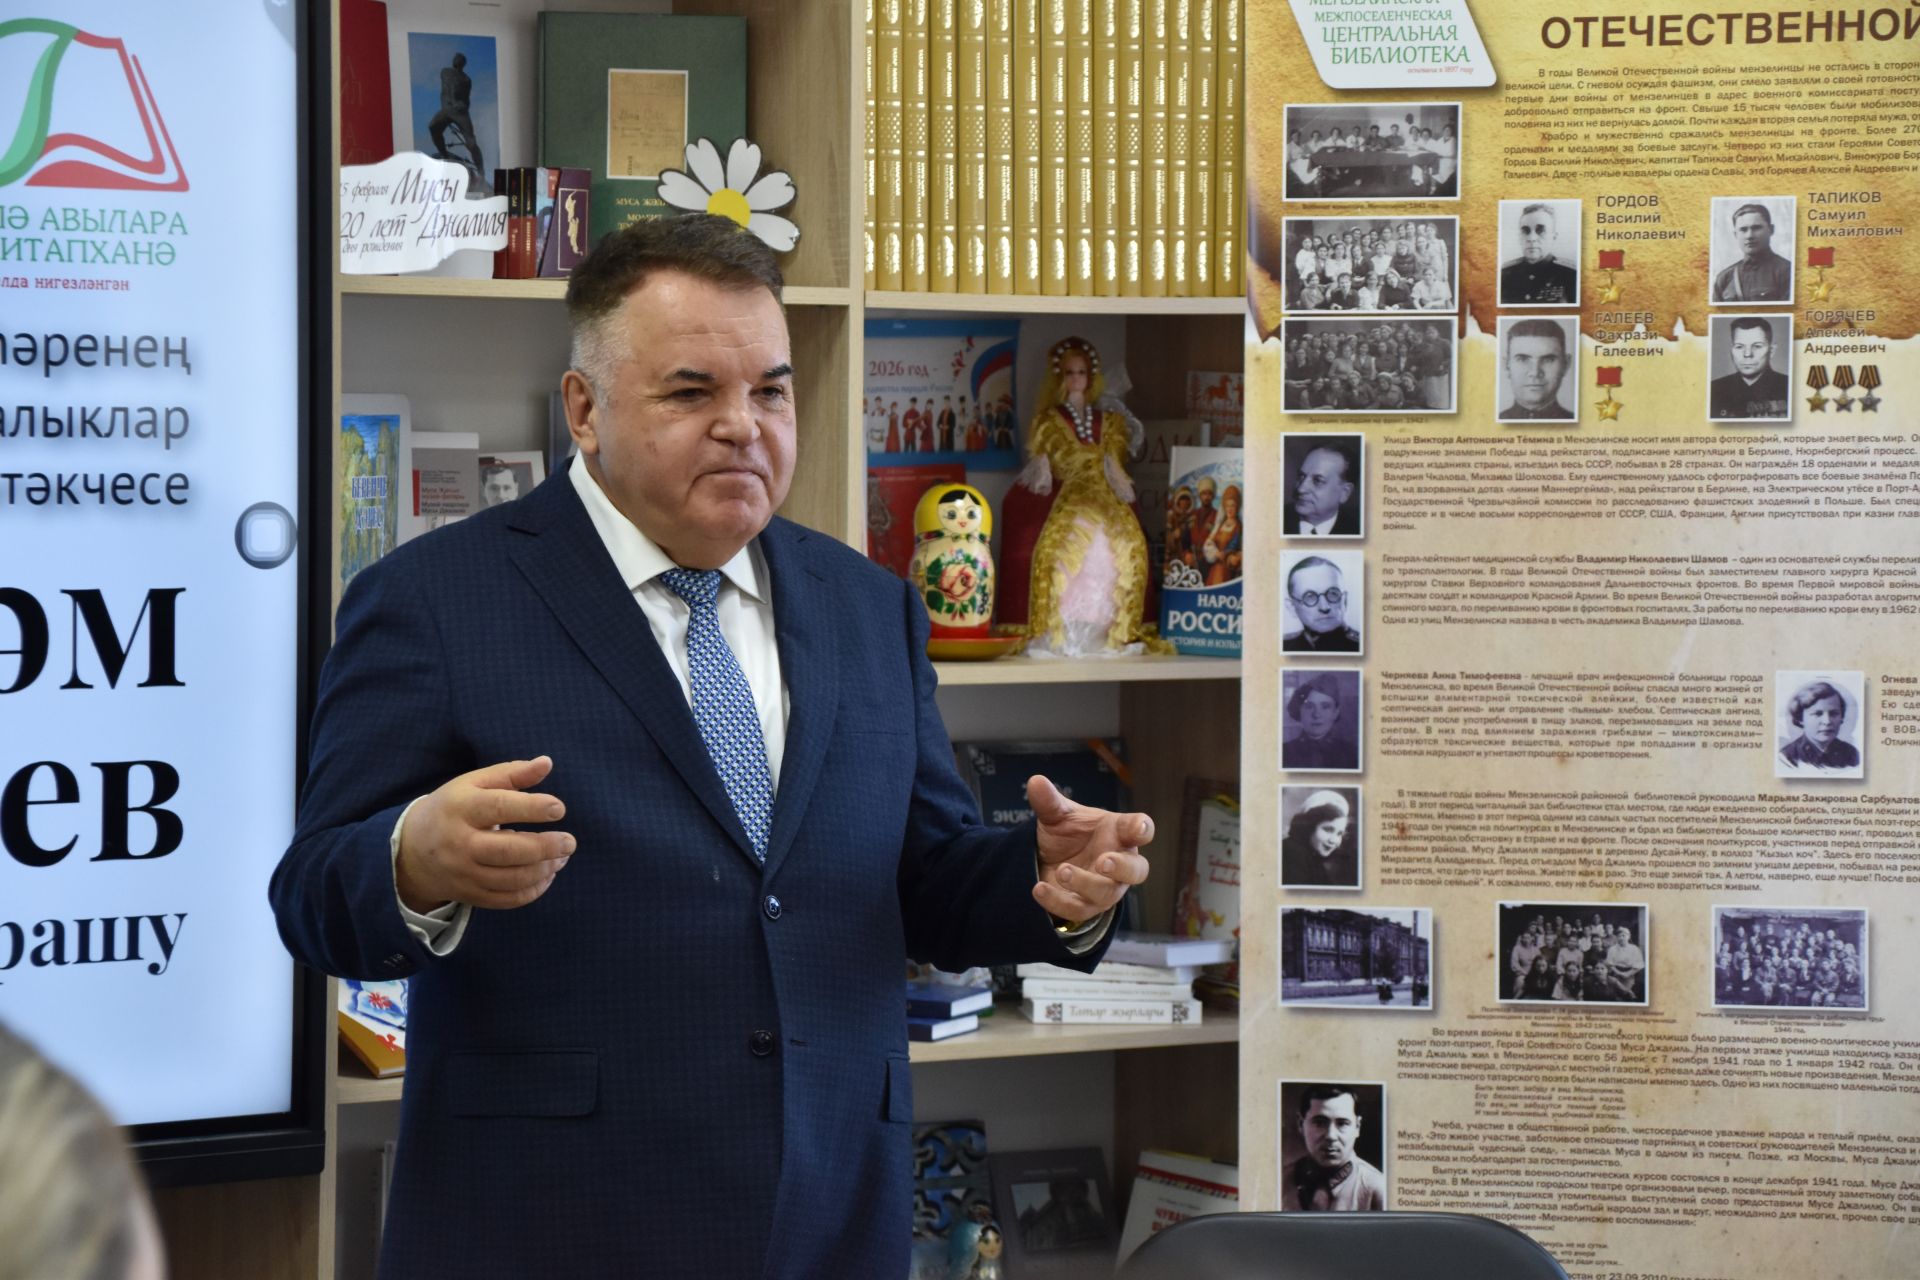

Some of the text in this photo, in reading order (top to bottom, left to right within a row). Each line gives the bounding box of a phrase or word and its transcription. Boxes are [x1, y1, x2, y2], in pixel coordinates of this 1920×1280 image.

[1315, 10, 1452, 22] МЕЖПОСЕЛЕНЧЕСКАЯ
[1322, 25, 1458, 46] ЦЕНТРАЛЬНАЯ
[1331, 46, 1471, 64] БИБЛИОТЕКА
[1538, 67, 1546, 77] В
[1549, 68, 1573, 78] годы
[1577, 65, 1619, 77] Великой
[1623, 64, 1699, 76] Отечественной
[1702, 63, 1736, 74] войны
[1739, 64, 1805, 76] мензелинцы
[1808, 63, 1821, 72] не
[1825, 62, 1870, 72] остались
[1873, 62, 1881, 71] в
[1505, 79, 1546, 90] великой
[1549, 80, 1574, 92] цели.
[1577, 78, 1584, 89] С
[1587, 79, 1624, 89] гневом
[1625, 78, 1668, 90] осуждая
[1670, 76, 1716, 89] фашизм,
[1719, 77, 1738, 86] они
[1740, 76, 1772, 86] смело
[1774, 75, 1821, 85] заявляли
[1822, 75, 1830, 84] о
[1832, 73, 1863, 84] своей
[391, 168, 459, 223] Мусы
[1597, 195, 1659, 208] ГОРДОВ
[1807, 191, 1882, 204] ТАПИКОВ
[0, 205, 188, 235] Ә АВЫЛАРА
[1597, 211, 1661, 224] Василий
[1807, 208, 1866, 223] Самуил
[370, 213, 407, 241] лет
[416, 203, 507, 247] Джалиля
[1596, 228, 1686, 240] Николаевич
[0, 277, 29, 289] лда
[1594, 312, 1654, 324] ГАЛЕЕВ
[1805, 310, 1876, 321] ГОРЯЧЕВ
[1594, 330, 1658, 342] Фахрази
[1805, 327, 1866, 338] Алексей
[0, 333, 191, 378] әренең
[1594, 345, 1664, 357] Галеевич
[1804, 342, 1886, 356] Андреевич
[868, 361, 930, 378] 2026 год
[1383, 433, 1920, 446] Улица Виктора Антоновича Тёмина в Мензелинске носит имя автора фотографий, которые знает весь мир. О
[1, 473, 190, 506] тәкчесе
[1382, 553, 1470, 566] Генерал-лейтенант
[1472, 553, 1538, 566] медицинской
[1539, 553, 1575, 566] службы
[1576, 553, 1627, 566] Владимир
[1628, 553, 1689, 564] Николаевич
[1691, 553, 1728, 564] Шамов
[1739, 555, 1764, 564] один
[1765, 555, 1777, 564] из
[1778, 553, 1841, 564] основателей
[1842, 553, 1880, 566] службы
[1167, 610, 1243, 634] РОССИ
[1381, 670, 1429, 683] Черняева
[1432, 670, 1457, 681] Анна
[1459, 670, 1522, 683] Тимофеевна
[1531, 670, 1573, 683] лечащий
[1577, 672, 1600, 683] врач
[1603, 670, 1675, 683] инфекционной
[1679, 671, 1726, 684] больницы
[1730, 673, 1763, 684] города
[1881, 674, 1918, 684] Огнева
[1397, 788, 1404, 799] В
[1407, 790, 1446, 799] тяжелые
[1449, 790, 1472, 800] годы
[1475, 788, 1506, 799] войны
[1508, 789, 1578, 800] Мензелинской
[1580, 789, 1628, 802] районной
[1634, 790, 1697, 801] библиотекой
[1699, 792, 1756, 804] руководила
[1757, 791, 1800, 804] Марьям
[1802, 792, 1858, 805] Закировна
[1397, 1048, 1913, 1071] Муса Джалиль жил в Мензелинске всего 56 дней: с 7 ноября 1941 года по 1 января 1942 года. Он
